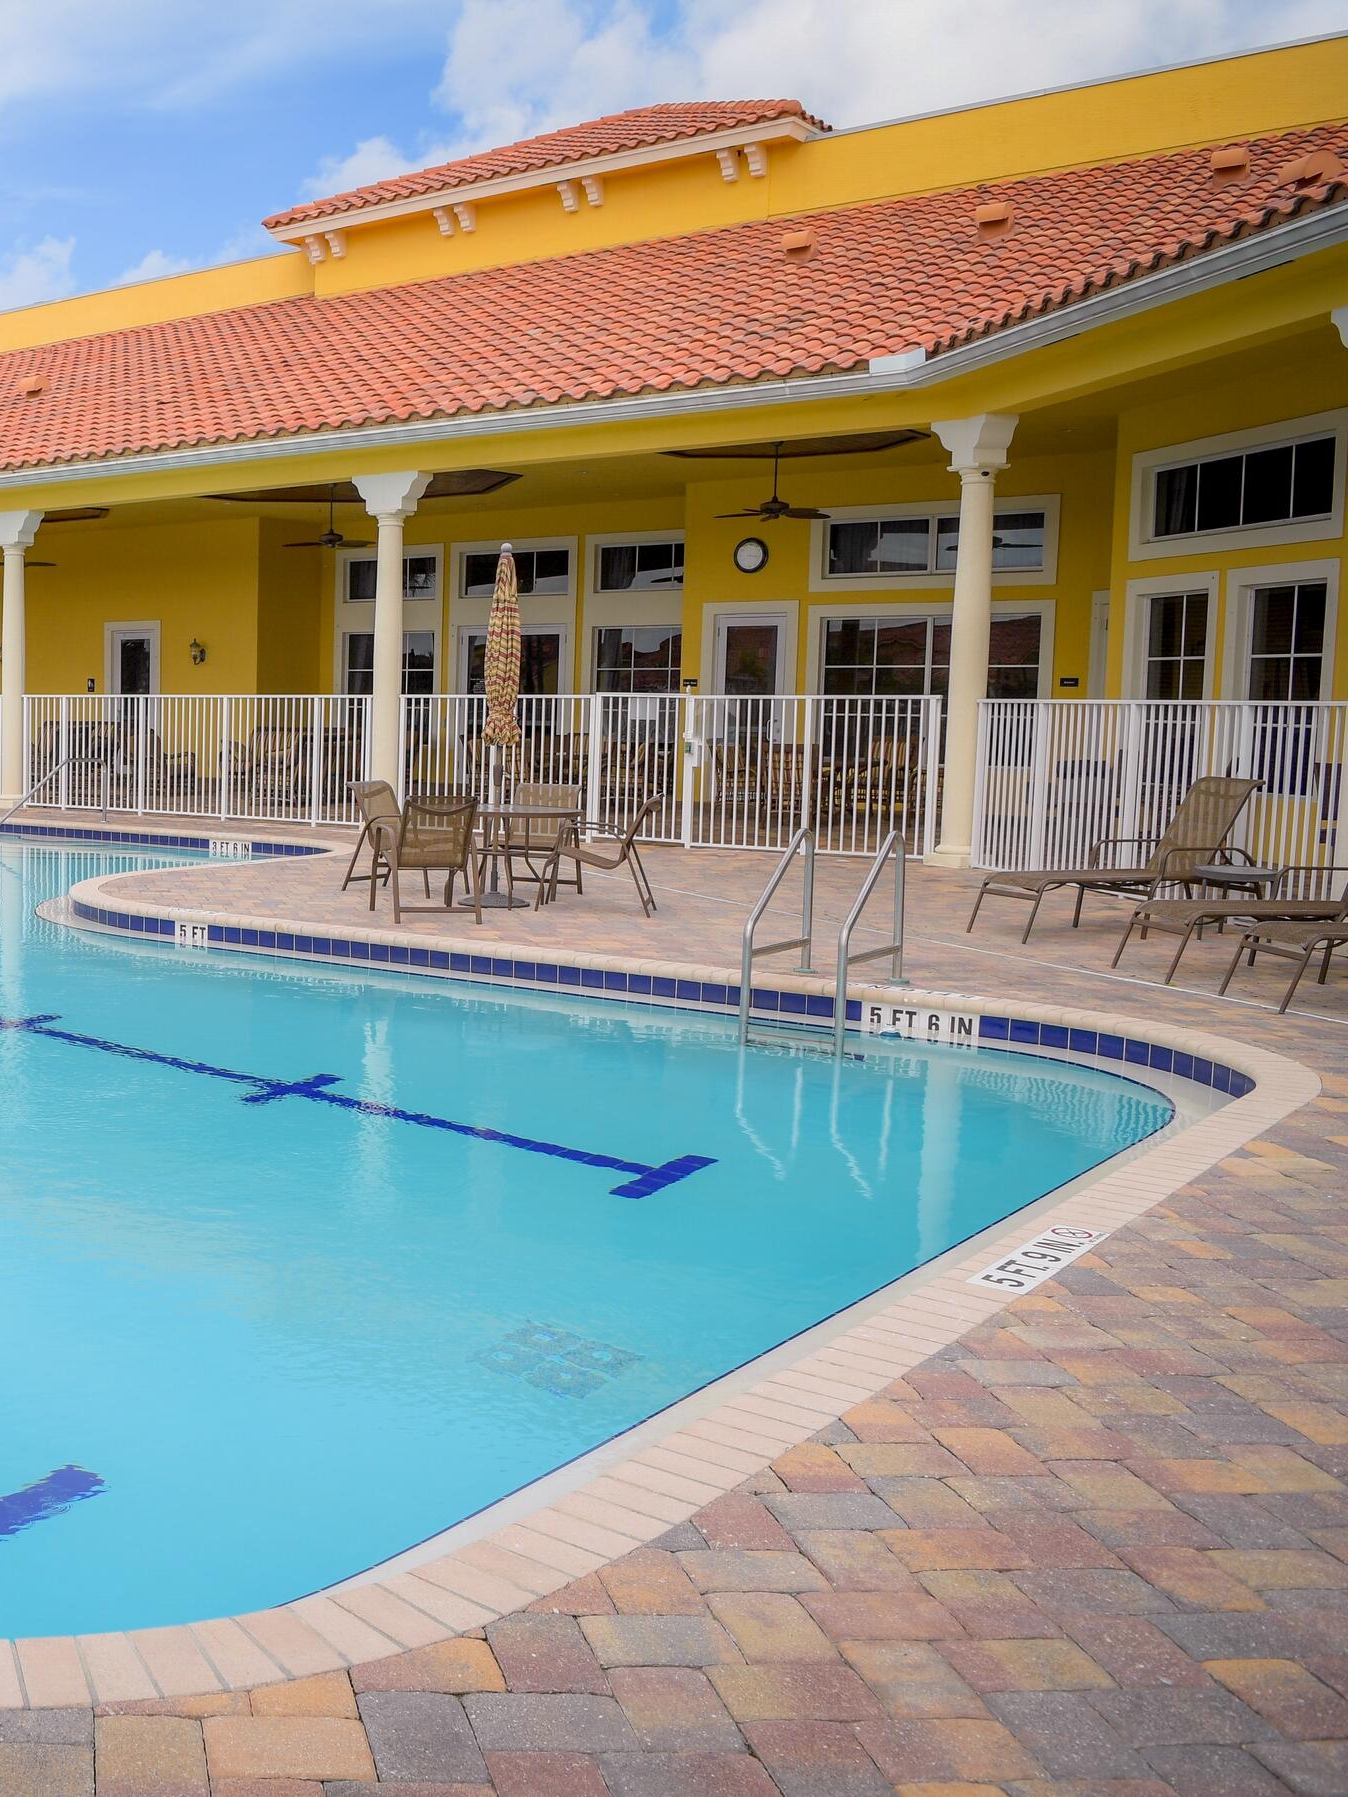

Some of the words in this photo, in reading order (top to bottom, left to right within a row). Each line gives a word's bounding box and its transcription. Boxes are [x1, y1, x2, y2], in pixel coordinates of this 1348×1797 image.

[212, 841, 217, 852] 3
[220, 841, 230, 852] FT
[233, 842, 238, 853] 6
[241, 842, 250, 853] IN
[180, 925, 186, 937] 5
[192, 926, 206, 939] FT
[870, 1006, 882, 1024] 5
[891, 1009, 917, 1028] FT
[928, 1014, 940, 1031] 6
[950, 1016, 973, 1035] IN
[1032, 1238, 1085, 1254] IN.
[1021, 1251, 1062, 1263] 9
[995, 1259, 1050, 1278] FT.
[980, 1274, 1025, 1288] 5
